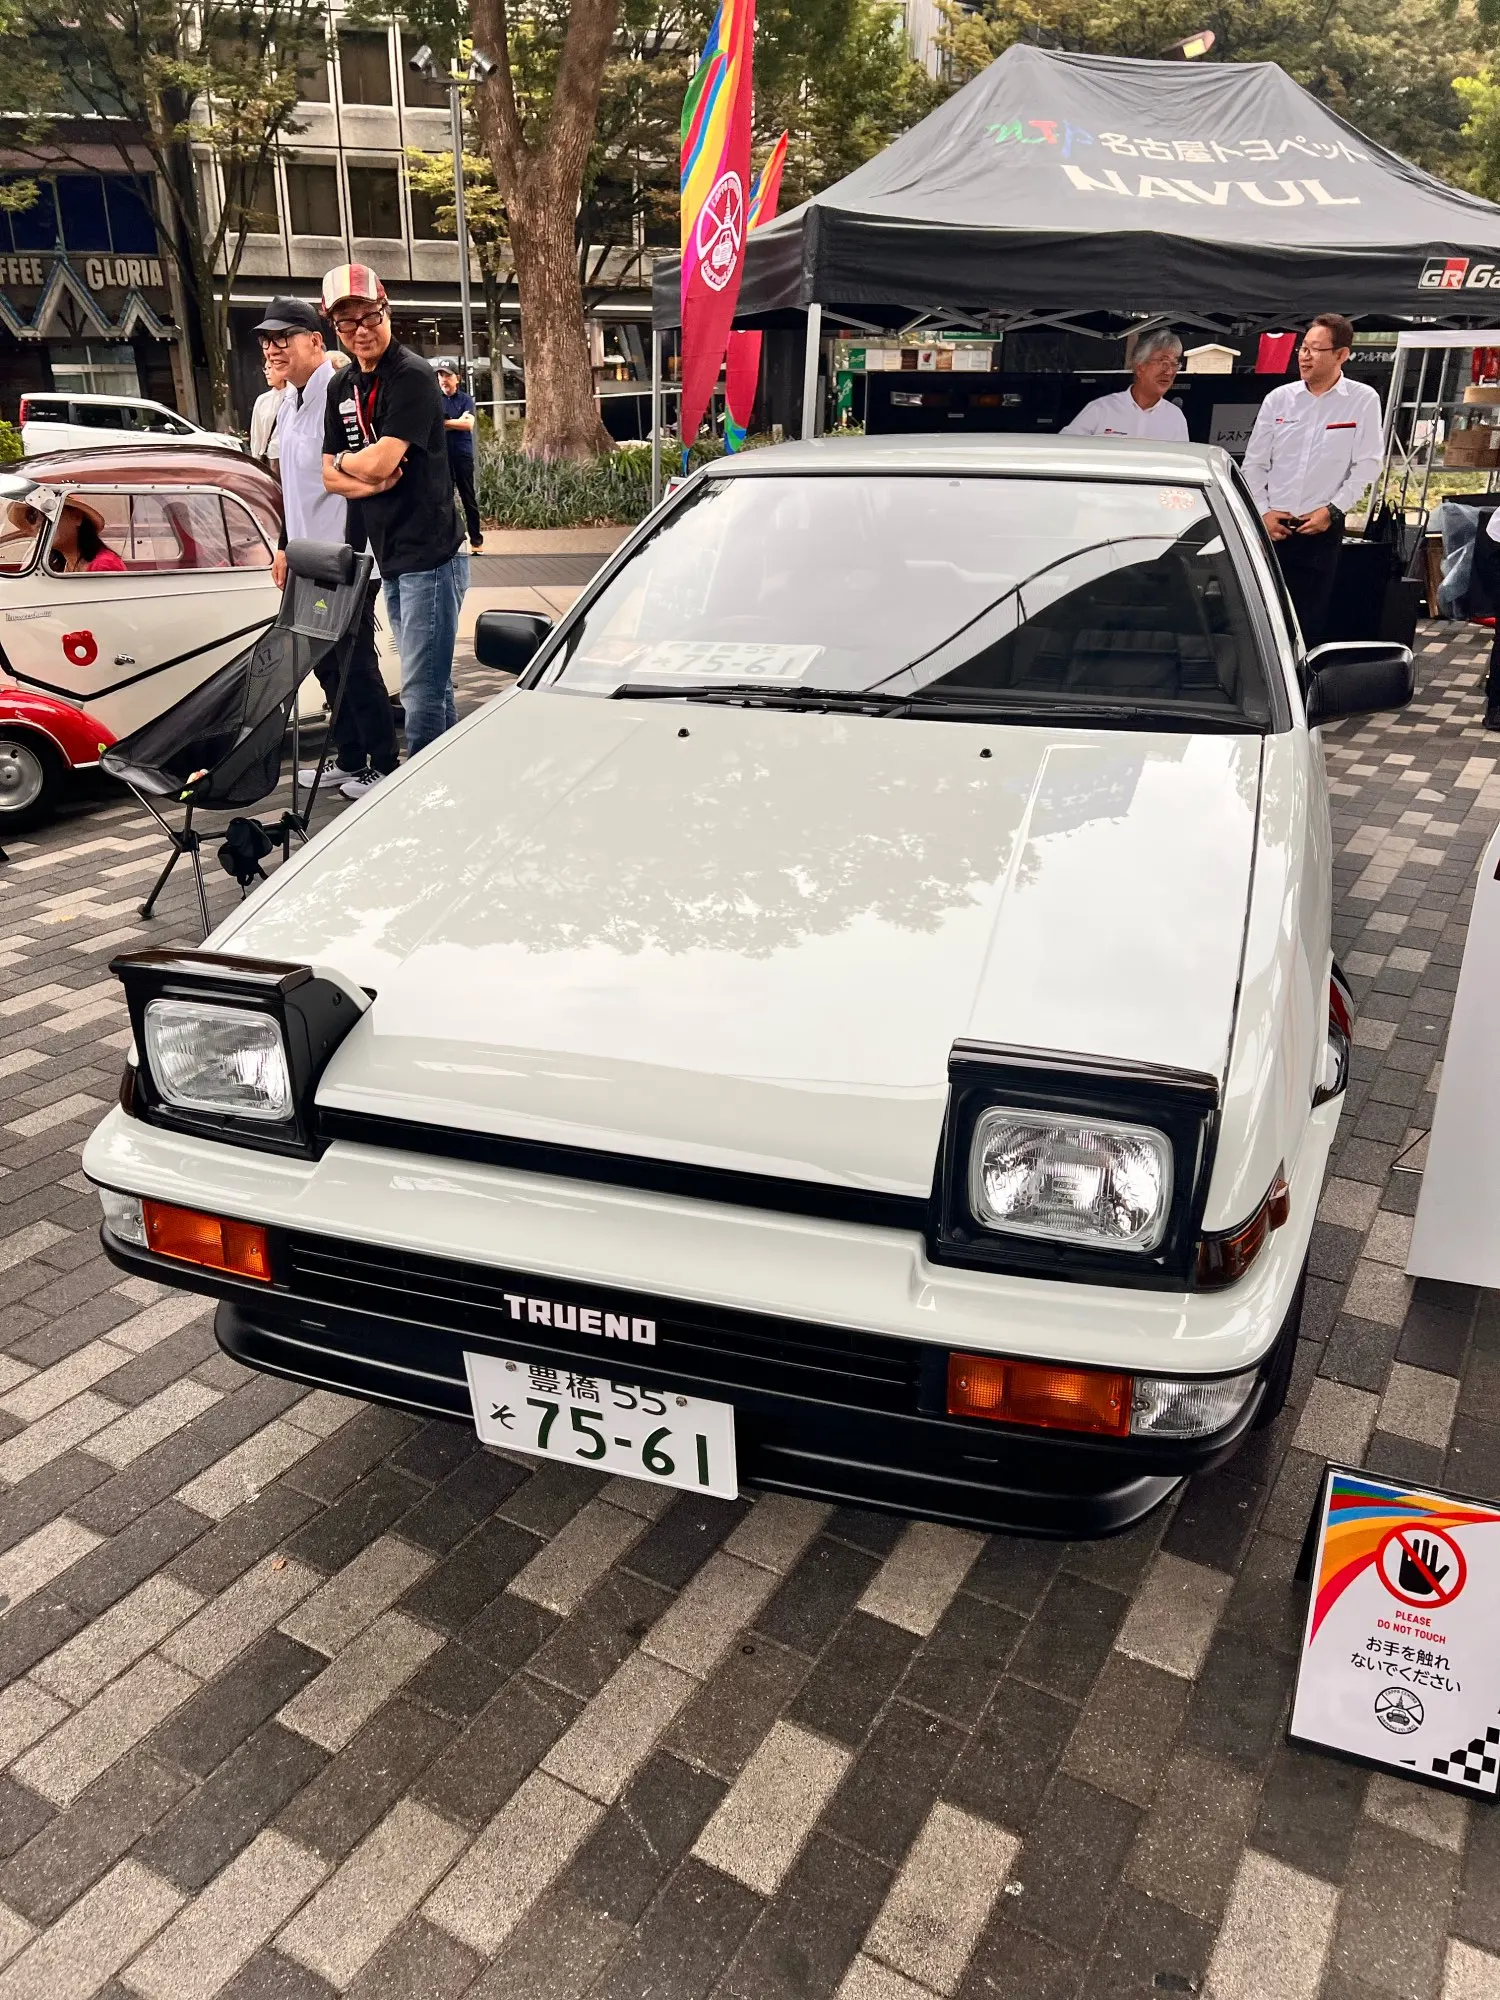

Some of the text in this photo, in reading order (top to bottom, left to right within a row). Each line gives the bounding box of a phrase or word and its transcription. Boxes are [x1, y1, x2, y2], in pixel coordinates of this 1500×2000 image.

[1098, 131, 1369, 163] 名古屋トヨペット
[1061, 164, 1361, 207] NAVUL
[85, 258, 164, 290] GLORIA
[503, 1294, 656, 1346] TRUENO
[527, 1364, 667, 1416] 豊橋 55
[526, 1397, 710, 1487] 75-61
[1377, 1619, 1446, 1645] DO NOT TOUCH
[1395, 1610, 1432, 1627] PLEASE
[1350, 1652, 1461, 1692] ないでください
[1366, 1636, 1451, 1671] お手を触れ
